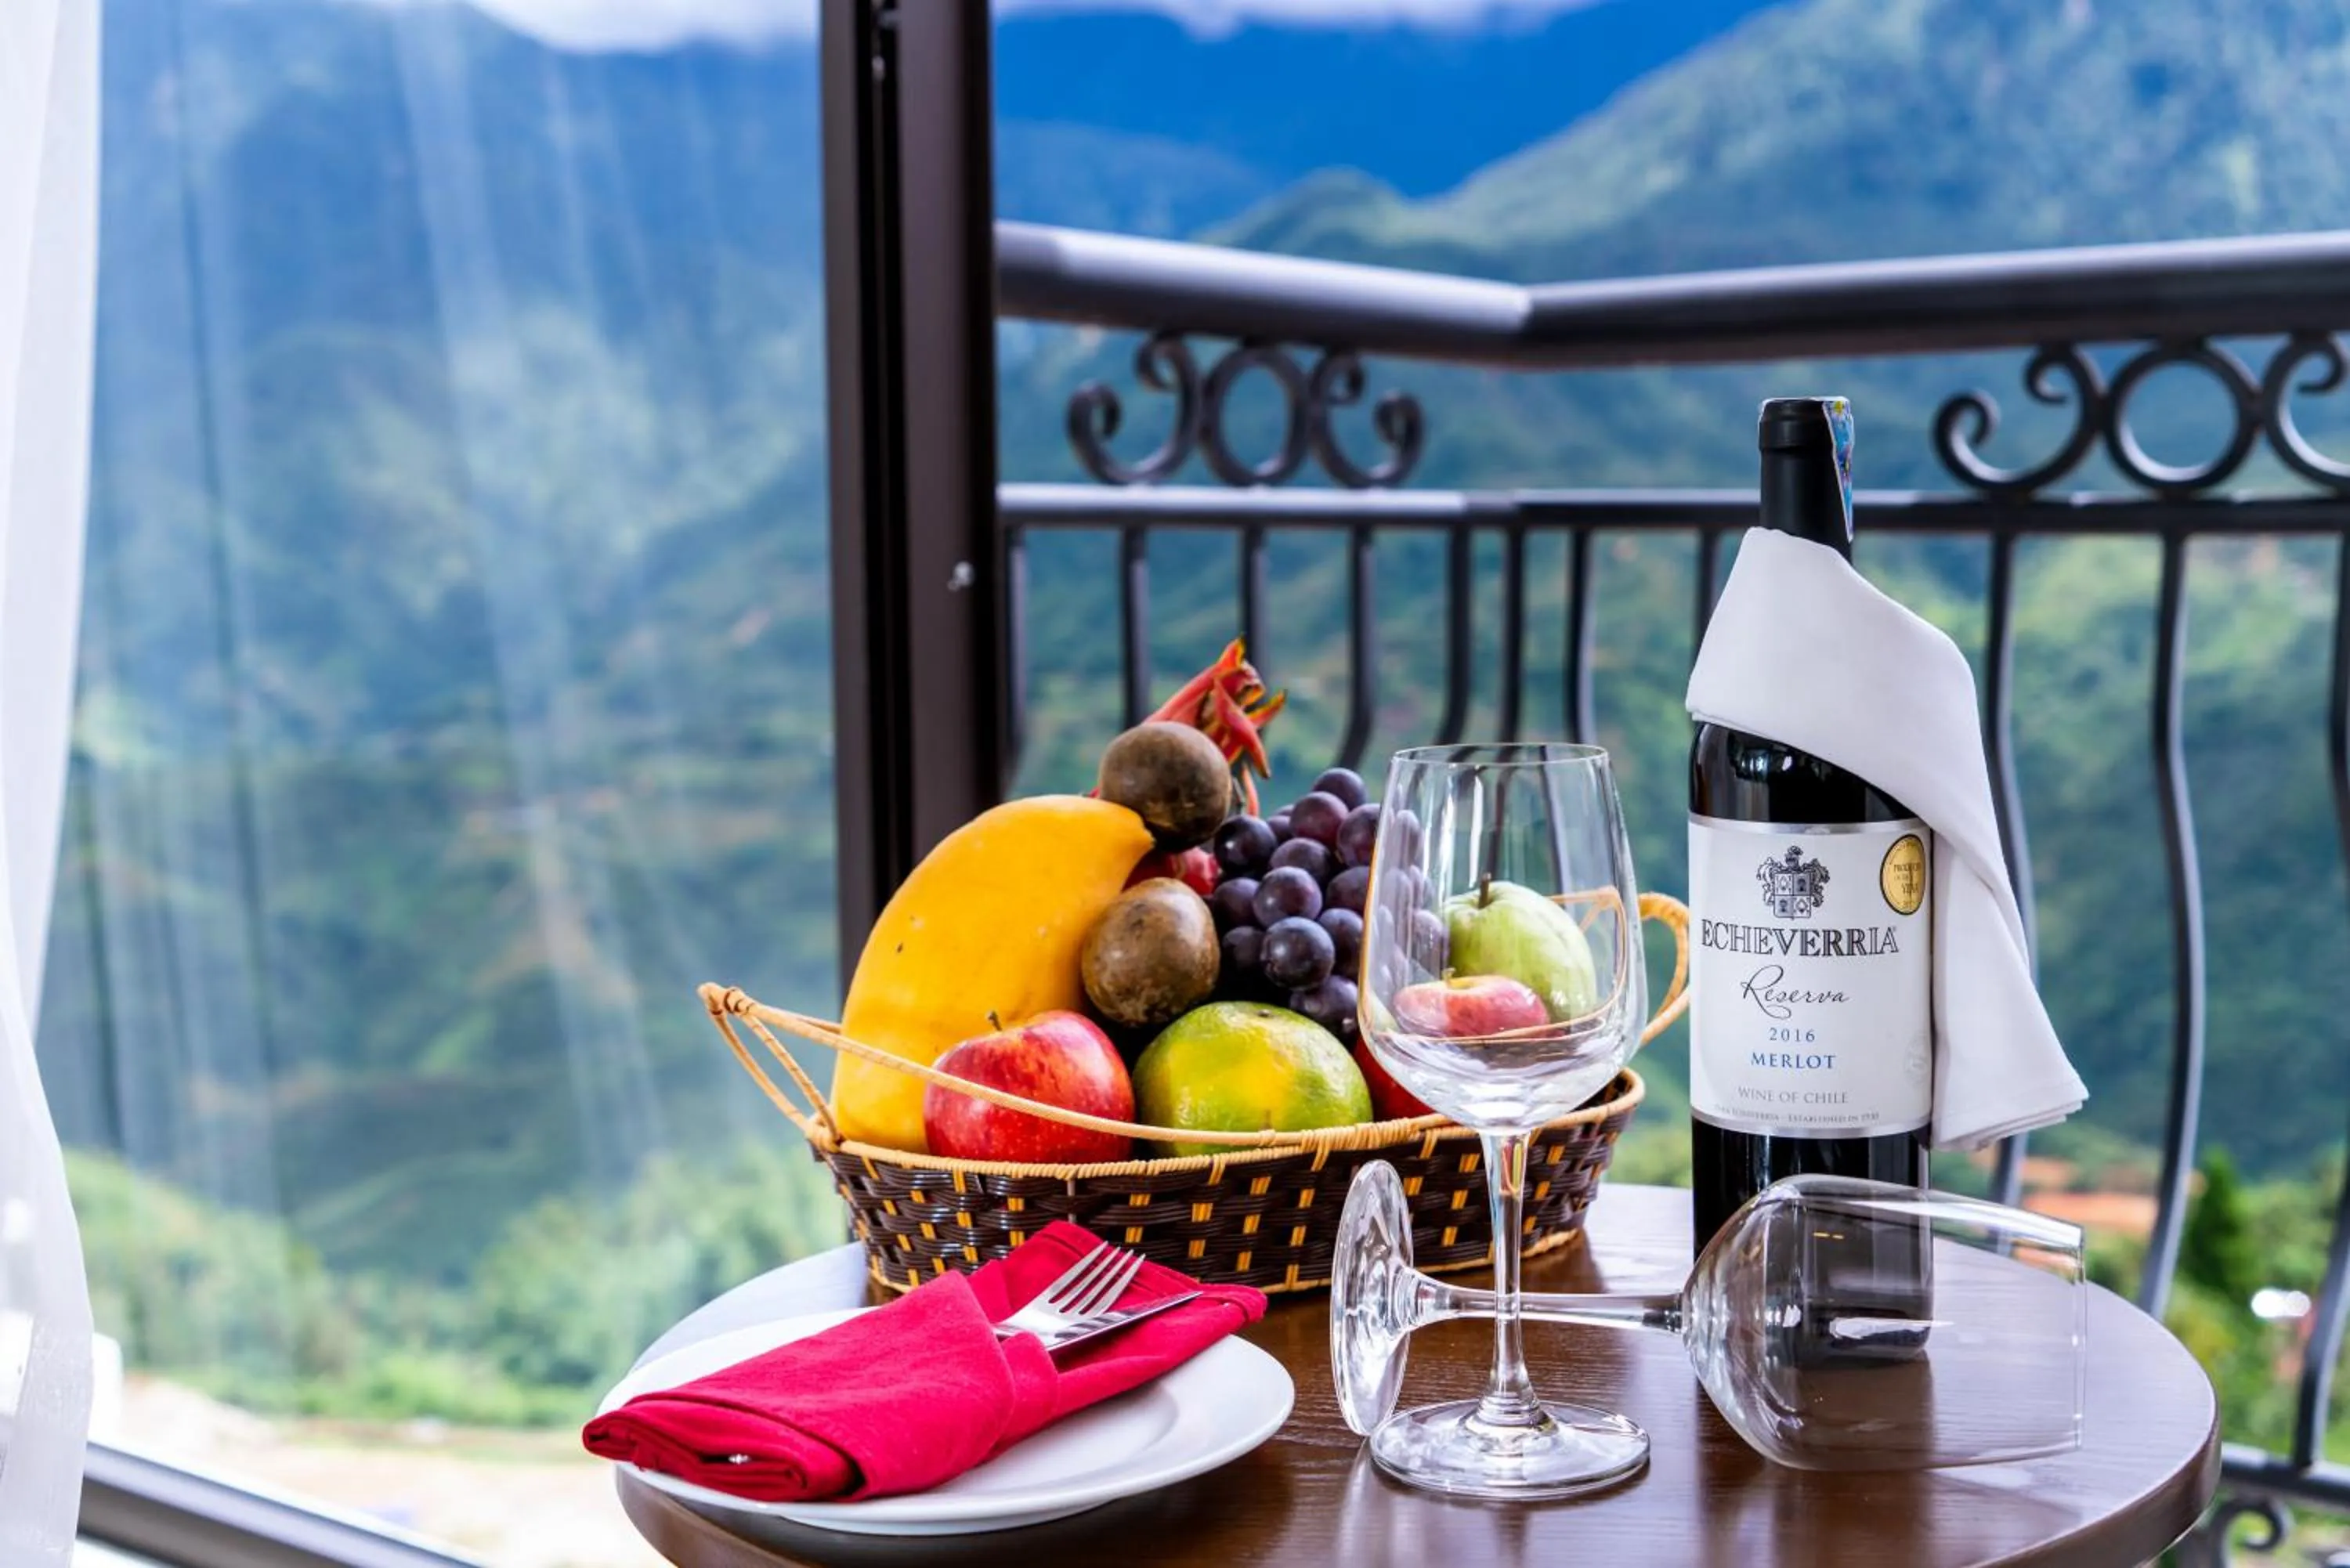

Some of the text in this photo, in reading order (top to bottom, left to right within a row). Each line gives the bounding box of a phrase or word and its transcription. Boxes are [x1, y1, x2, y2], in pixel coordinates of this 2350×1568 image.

[1701, 919, 1899, 956] ECHEVERRIA
[1741, 965, 1849, 1019] Reserva
[1769, 1028, 1816, 1042] 2016
[1751, 1052, 1836, 1069] MERLOT
[1738, 1086, 1849, 1104] WINE OF CHILE
